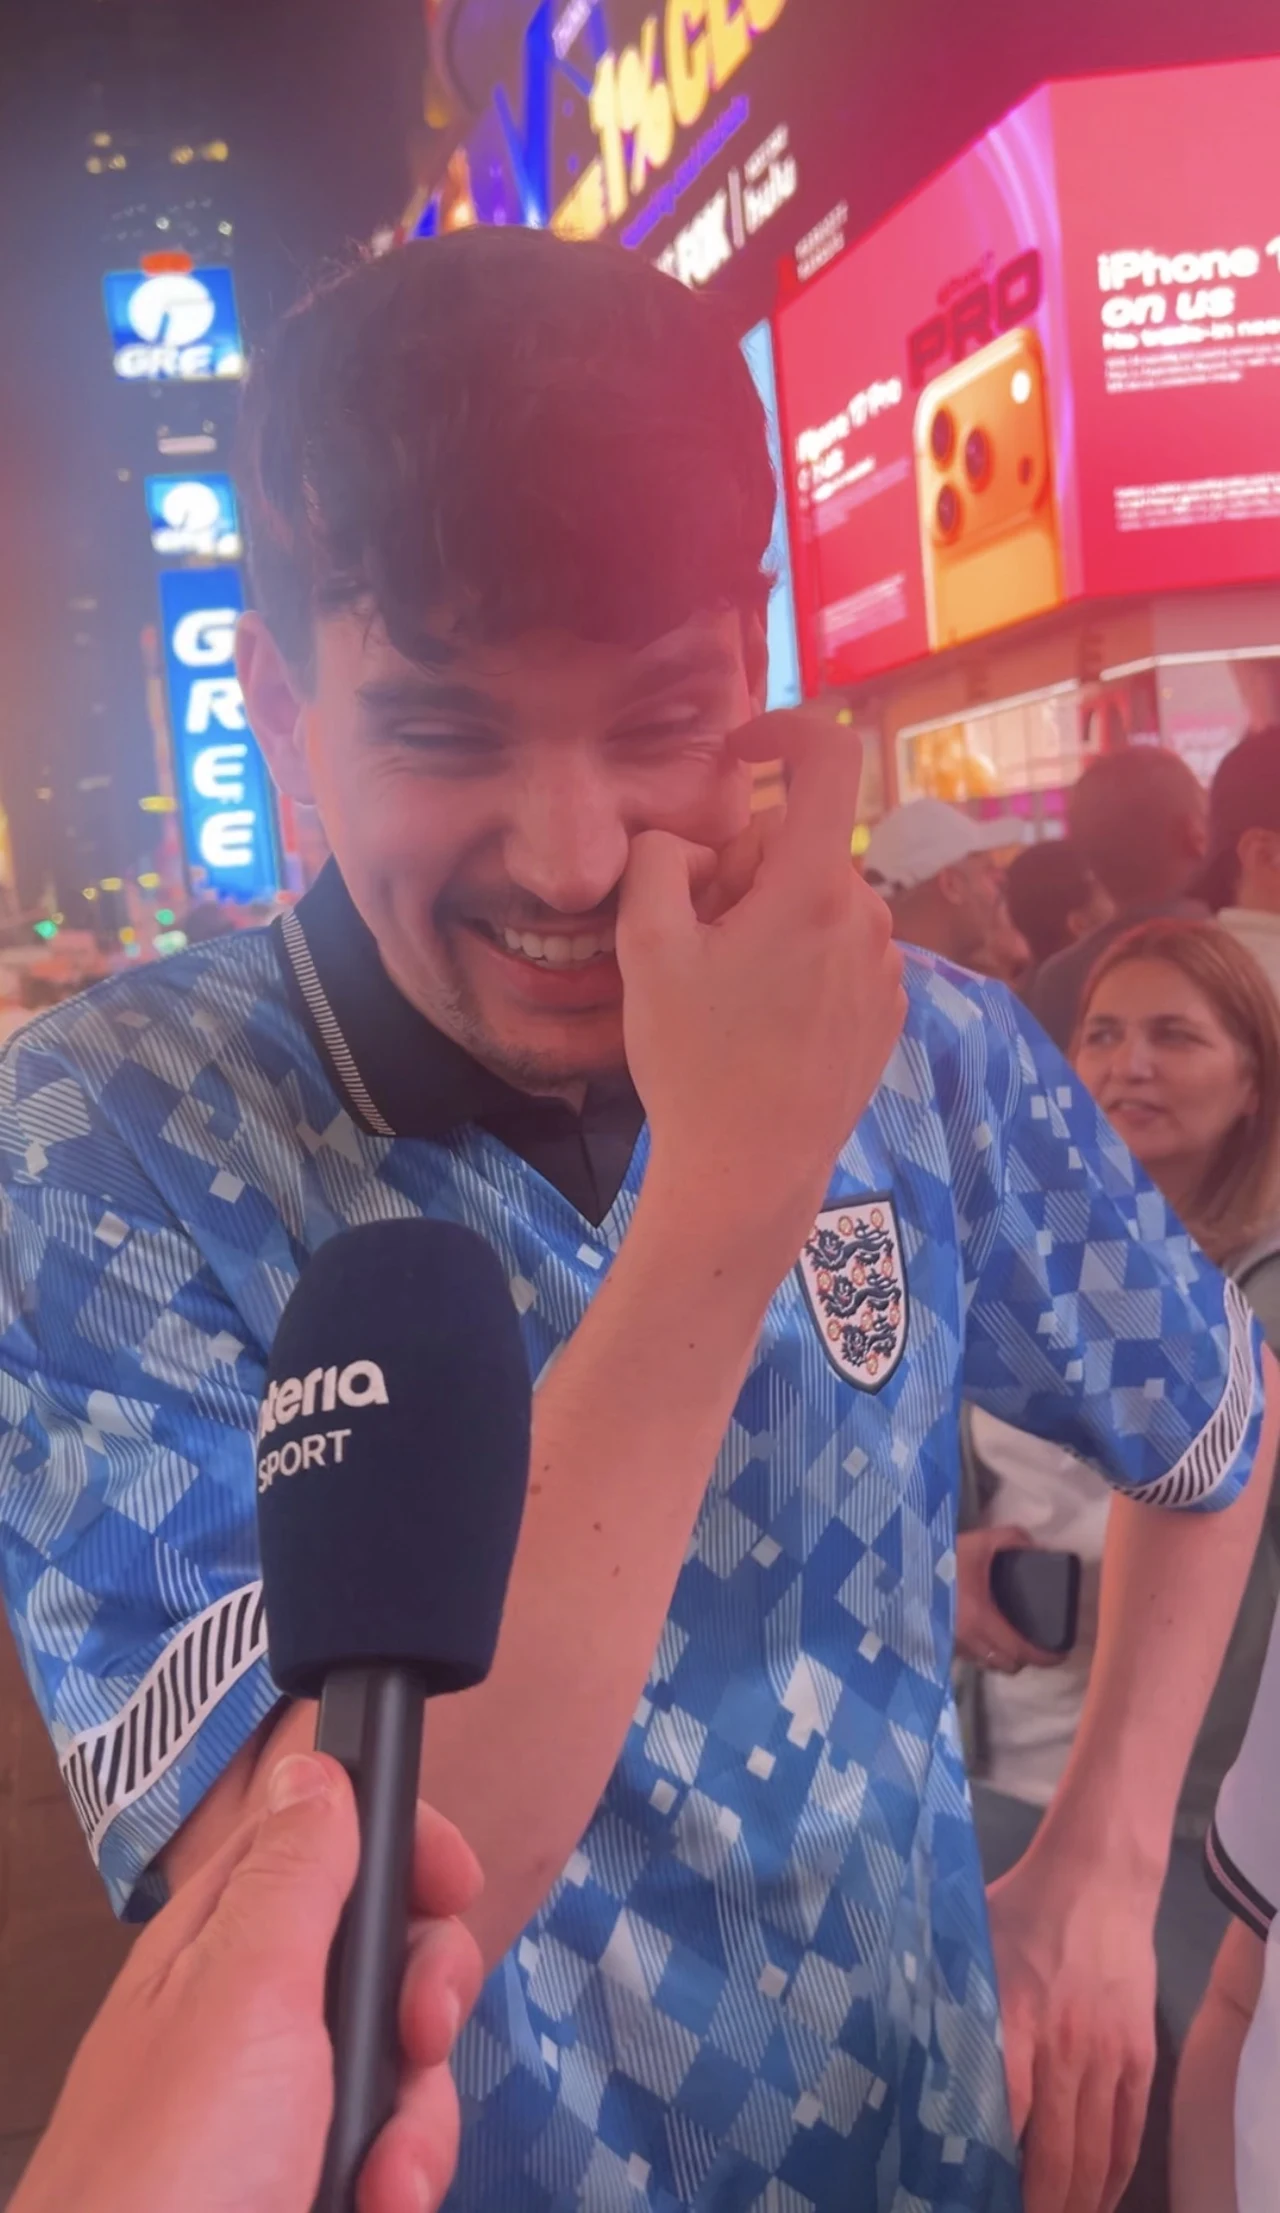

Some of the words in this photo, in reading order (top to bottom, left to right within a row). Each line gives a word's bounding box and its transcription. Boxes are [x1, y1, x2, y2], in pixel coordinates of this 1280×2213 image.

[1098, 247, 1260, 291] iPhone
[907, 248, 1042, 393] PRO
[1101, 293, 1167, 330] on
[1175, 286, 1235, 321] us
[172, 607, 255, 867] GREE
[258, 1428, 352, 1493] SPORT
